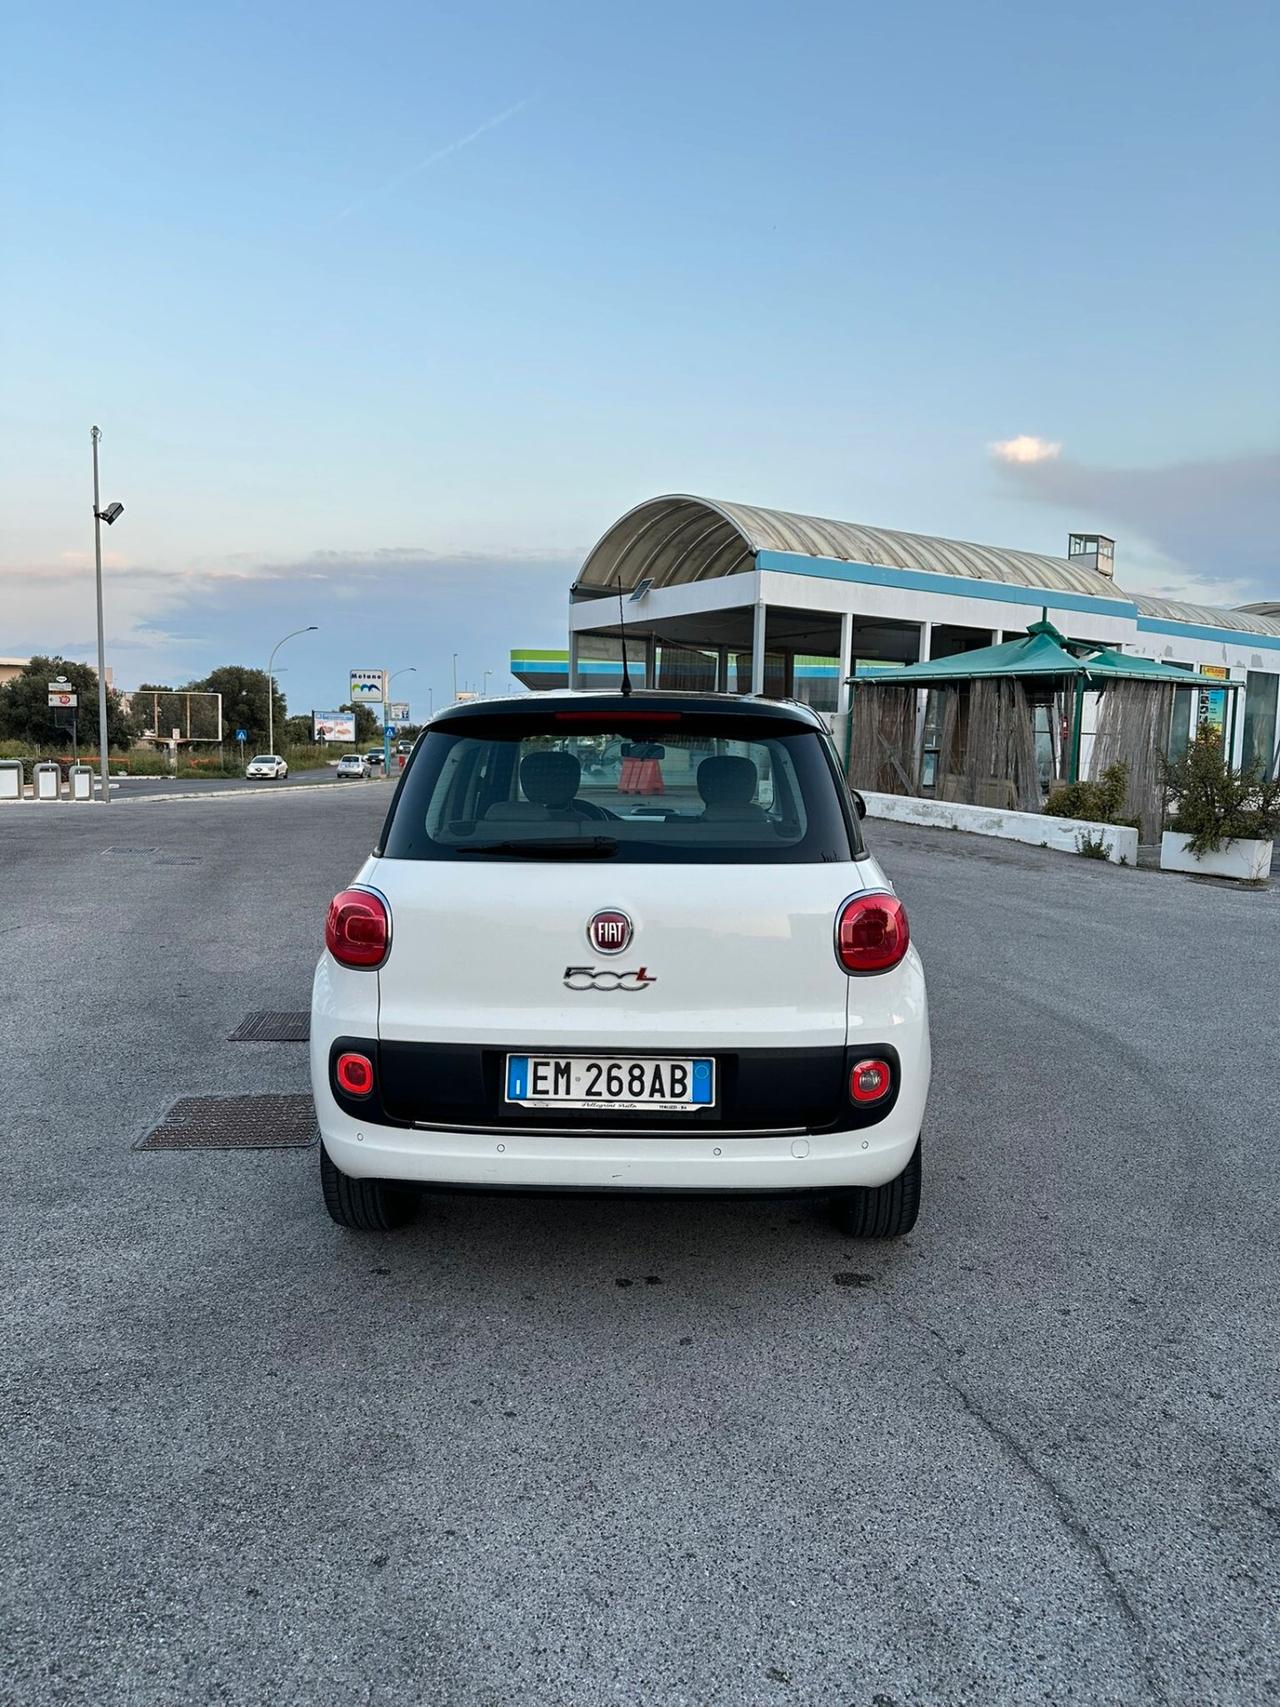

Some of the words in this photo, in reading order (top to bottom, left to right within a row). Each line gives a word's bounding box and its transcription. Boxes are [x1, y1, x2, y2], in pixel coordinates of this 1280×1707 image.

[598, 922, 624, 942] FIAT
[563, 966, 657, 991] 500L
[532, 1061, 571, 1096] EM
[585, 1063, 688, 1098] 268AB
